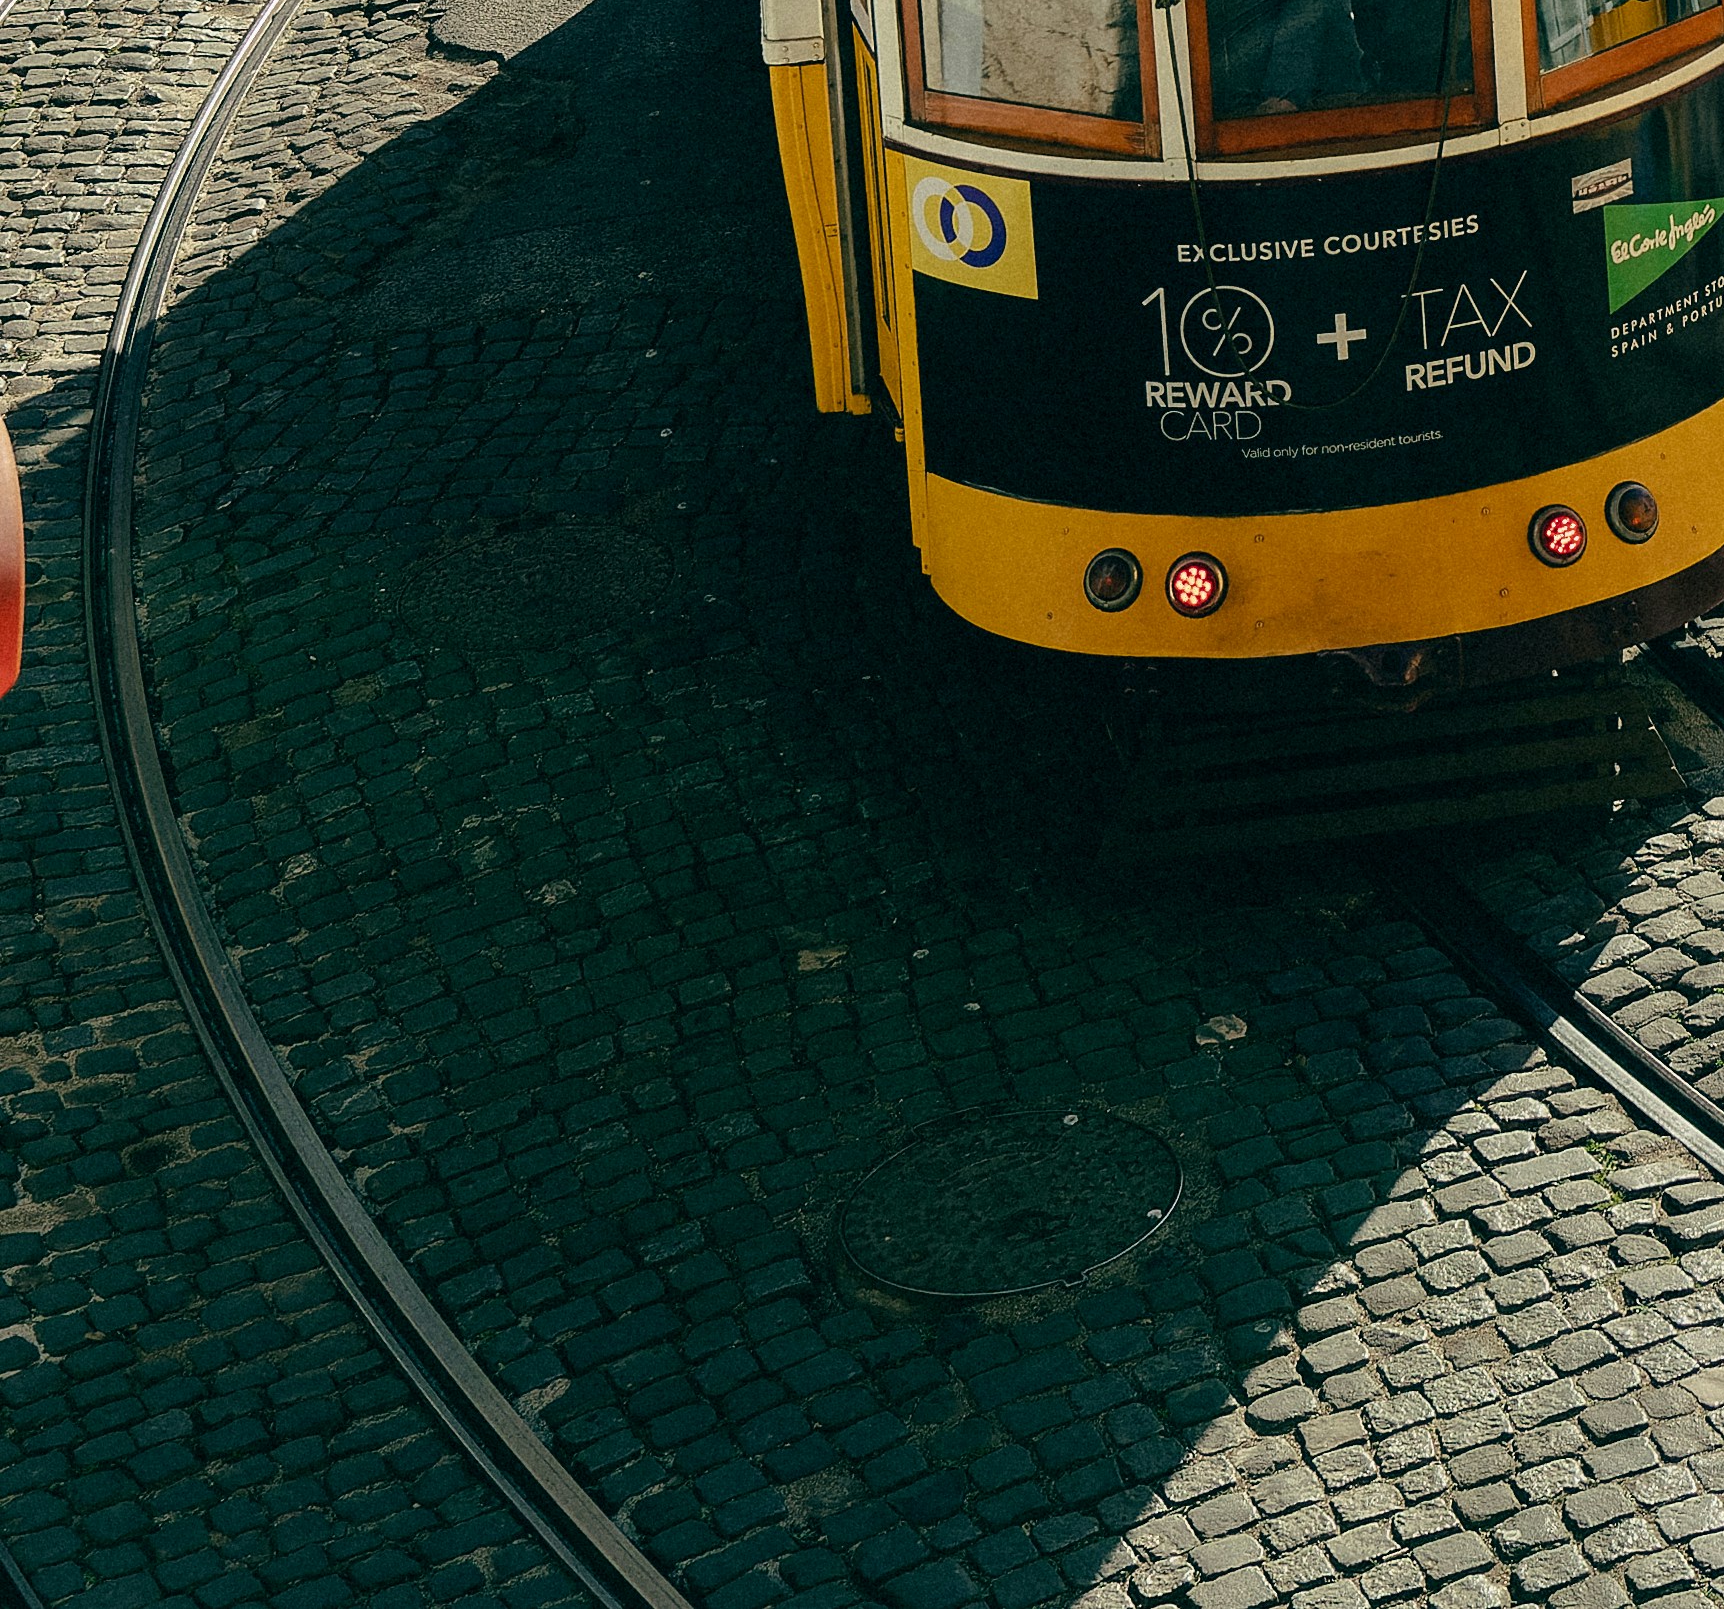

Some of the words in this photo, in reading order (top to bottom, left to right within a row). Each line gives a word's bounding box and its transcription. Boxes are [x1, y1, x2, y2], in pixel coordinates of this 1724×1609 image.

[1176, 238, 1315, 264] EXCLUSIVE
[1323, 214, 1480, 256] COURTESIES
[1610, 239, 1630, 265] El
[1629, 229, 1668, 258] Corte
[1400, 269, 1533, 351] TAX
[1610, 290, 1700, 340] DEPARTMENT
[1611, 329, 1658, 358] SPAIN
[1665, 323, 1674, 335] &
[1404, 341, 1537, 392] REFUND
[1145, 379, 1292, 409] REWARD
[1160, 410, 1263, 441] CARD
[1241, 446, 1271, 460] Valid
[1273, 444, 1300, 460] only
[1300, 443, 1320, 457] for
[1321, 436, 1397, 455] non-resident
[1398, 429, 1444, 446] tourists.
